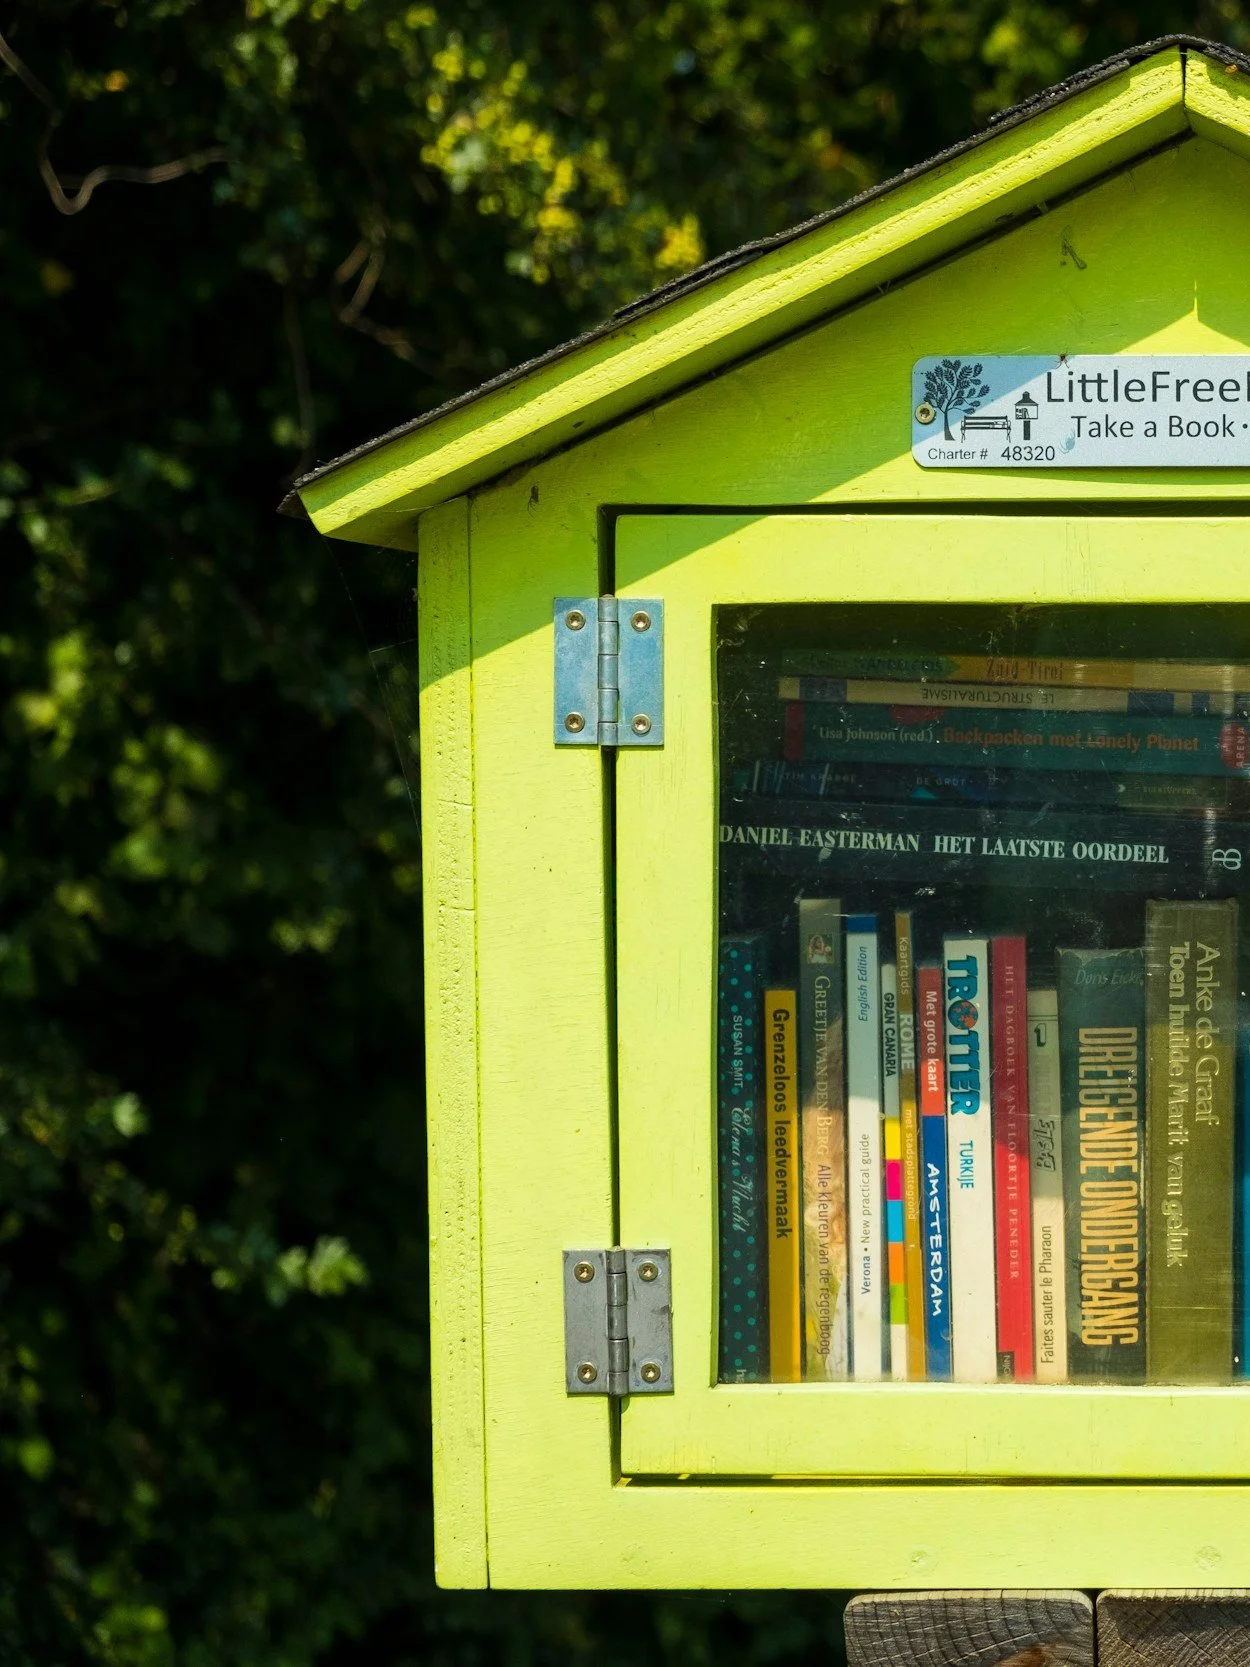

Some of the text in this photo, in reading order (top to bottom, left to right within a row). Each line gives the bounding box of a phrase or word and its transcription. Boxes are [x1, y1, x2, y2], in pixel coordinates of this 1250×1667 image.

[928, 445, 1056, 462] Charter # 48320
[1071, 415, 1134, 438] Take
[1143, 421, 1157, 438] a
[1168, 414, 1236, 438] Book
[922, 688, 1055, 705] LE STRUCTURALISME
[819, 727, 933, 743] Lisa Johnson (red.)
[944, 727, 1199, 753] Backpacken met Lonely Planet
[1235, 727, 1247, 768] ARENA
[720, 824, 920, 852] DANIEL EASTERMAN
[934, 835, 1170, 864] HET LAATSTE OORDEEL
[857, 946, 870, 1022] English Edition
[898, 936, 915, 1071] Kaartgids ROME
[733, 1015, 745, 1088] SUSAN SMIT
[811, 975, 832, 1155] GREETJE VAN DEN BERG
[884, 992, 897, 1077] GRAN CANARIA
[923, 990, 940, 1092] Met grote kaart
[947, 955, 981, 1116] TROTTER
[1195, 941, 1220, 1126] Anke de Graaf
[772, 1008, 793, 1239] Grenzeloos leedvermaak
[1004, 965, 1020, 1280] HET DAGBOEK VAN FLOORTJE PENEDER
[1162, 941, 1190, 1267] Toen huilde Marit van geluk
[860, 1134, 873, 1165] guide
[904, 1109, 918, 1220] met stadsplattegrond
[957, 1140, 975, 1189] TURKIJE
[1079, 1027, 1139, 1345] DREIGENDE ONDERGANG
[860, 1169, 873, 1216] practical
[816, 1164, 833, 1355] Alle kleuren van de regenboog
[861, 1220, 872, 1243] New
[926, 1162, 943, 1316] AMSTERDAM
[861, 1255, 872, 1295] Verona
[1039, 1225, 1055, 1364] Faites sauter le Pharaon
